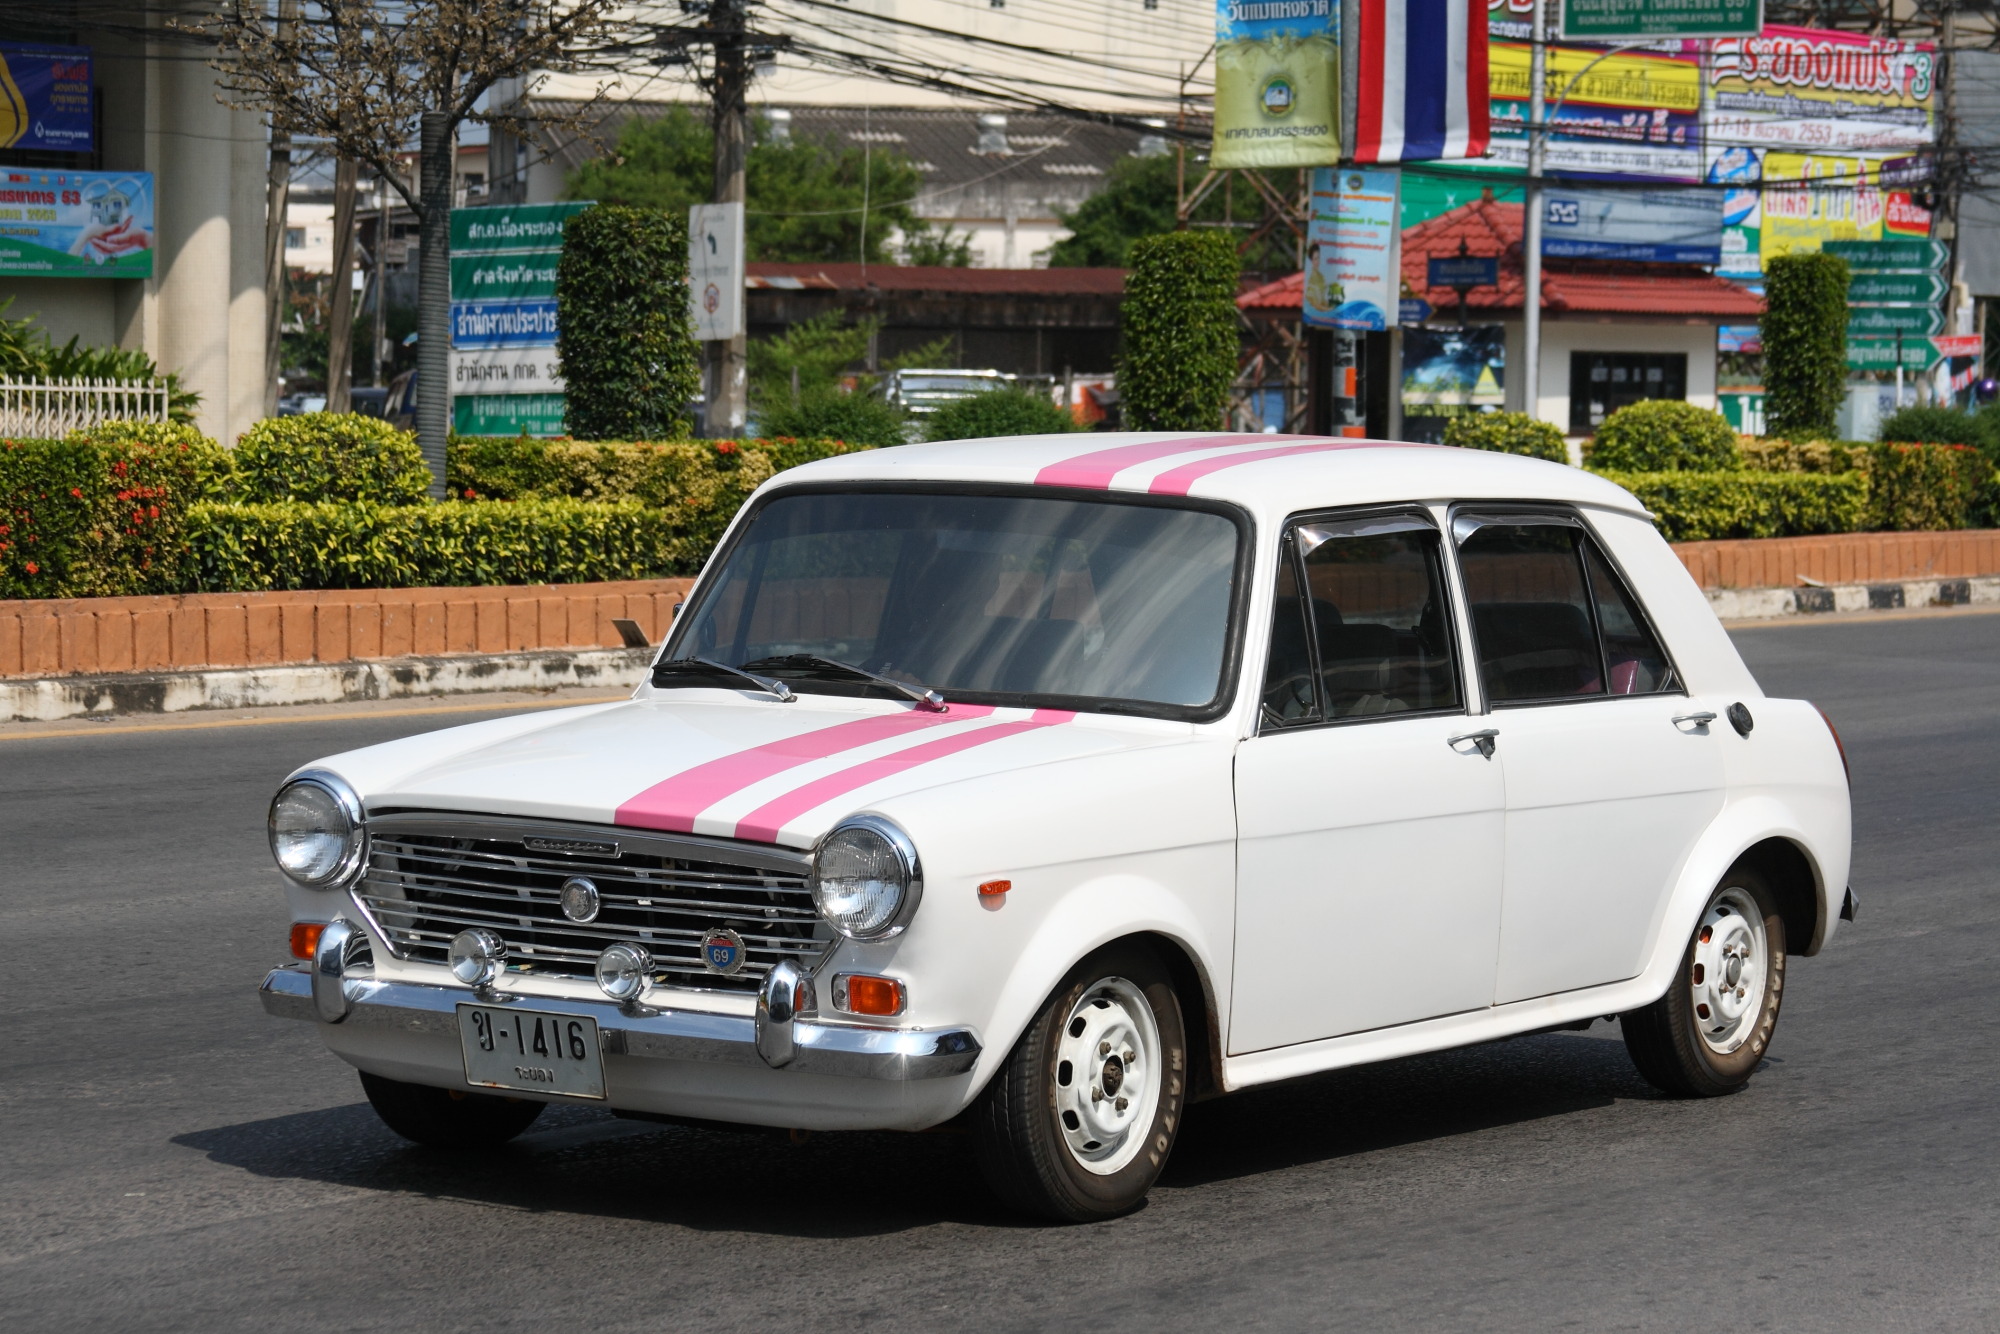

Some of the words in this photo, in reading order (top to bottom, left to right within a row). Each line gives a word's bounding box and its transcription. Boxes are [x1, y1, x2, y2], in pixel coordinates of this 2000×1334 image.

[1227, 0, 1329, 21] วันแมแหงชาต
[1573, 0, 1643, 15] ถนนสุขุมวท
[1578, 15, 1635, 25] SUKHUMVIT
[1641, 13, 1723, 24] NAKORNRAYONG
[1225, 124, 1329, 139] เทศบาลนครระยอง
[1799, 123, 1833, 141] 2553
[61, 189, 82, 206] 53
[473, 265, 557, 285] ศาลจังหวัดระย
[458, 304, 556, 336] สำนักงานประปาร
[456, 358, 508, 382] สำนักงาน
[713, 948, 729, 963] 69
[1752, 951, 1783, 1056] MAXXIS
[514, 1065, 554, 1083] ระยอง
[1149, 1048, 1182, 1167] MA-701
